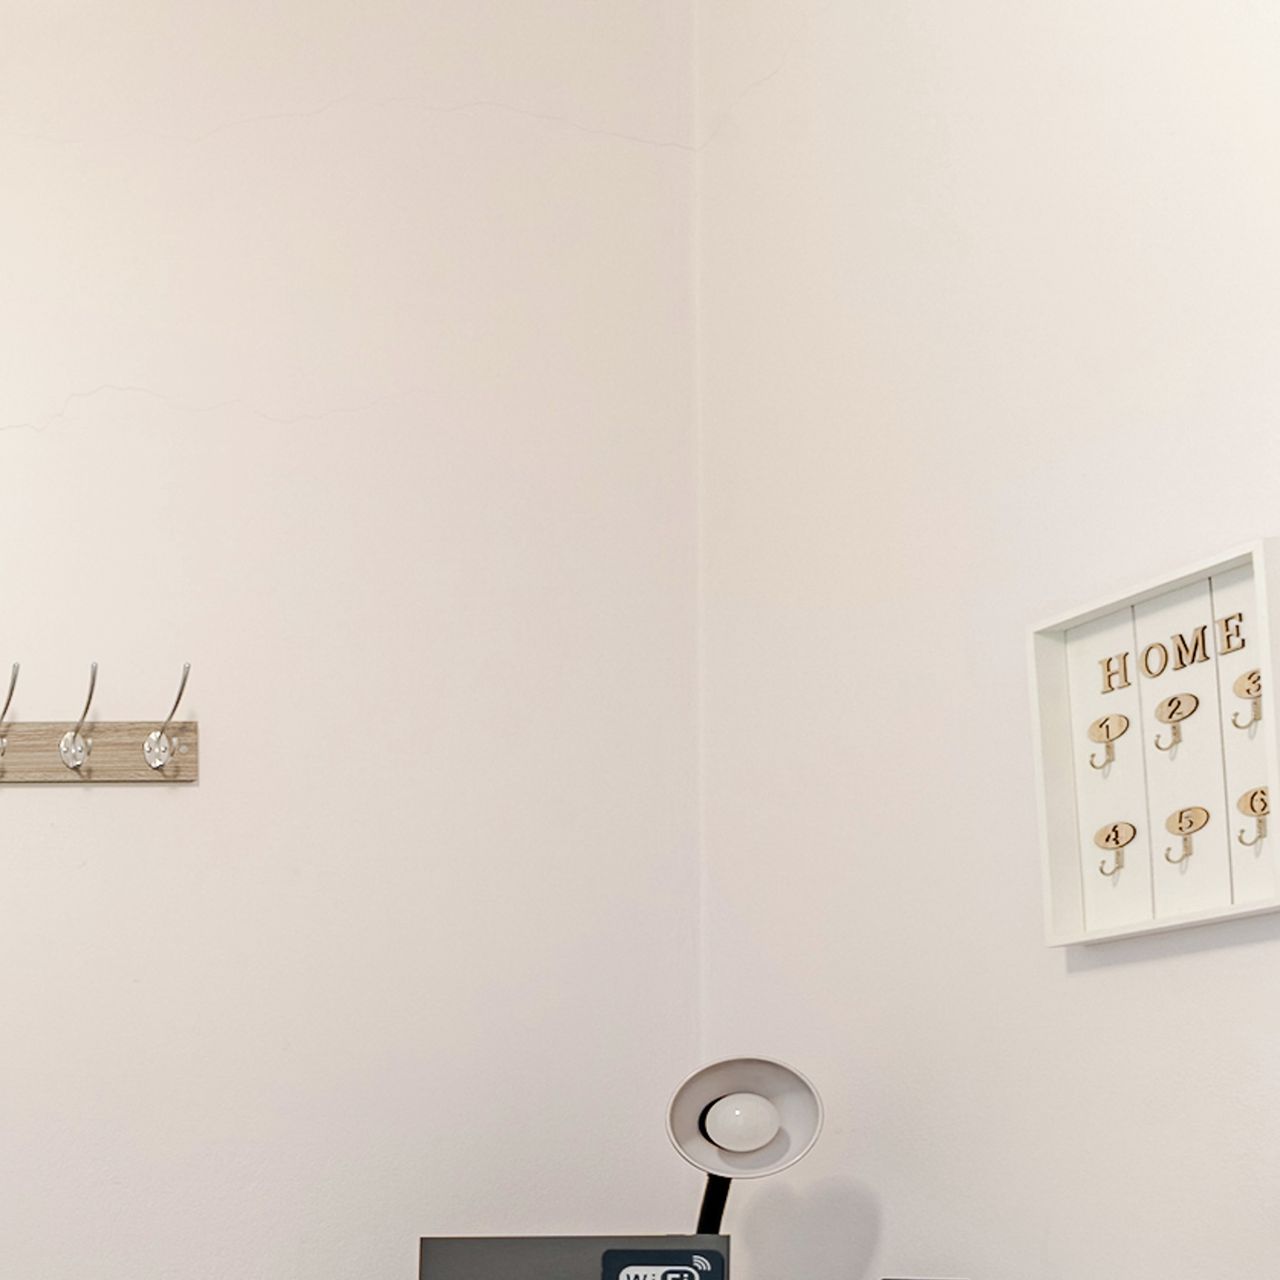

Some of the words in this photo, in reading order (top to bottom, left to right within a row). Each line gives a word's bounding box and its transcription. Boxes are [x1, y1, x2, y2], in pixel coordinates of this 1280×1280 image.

[1098, 612, 1246, 694] HOME
[1098, 716, 1111, 740] 1
[1167, 695, 1183, 720] 2
[1245, 670, 1262, 695] 3
[1104, 824, 1120, 846] 4
[1178, 810, 1194, 832] 5
[1249, 789, 1268, 813] 6
